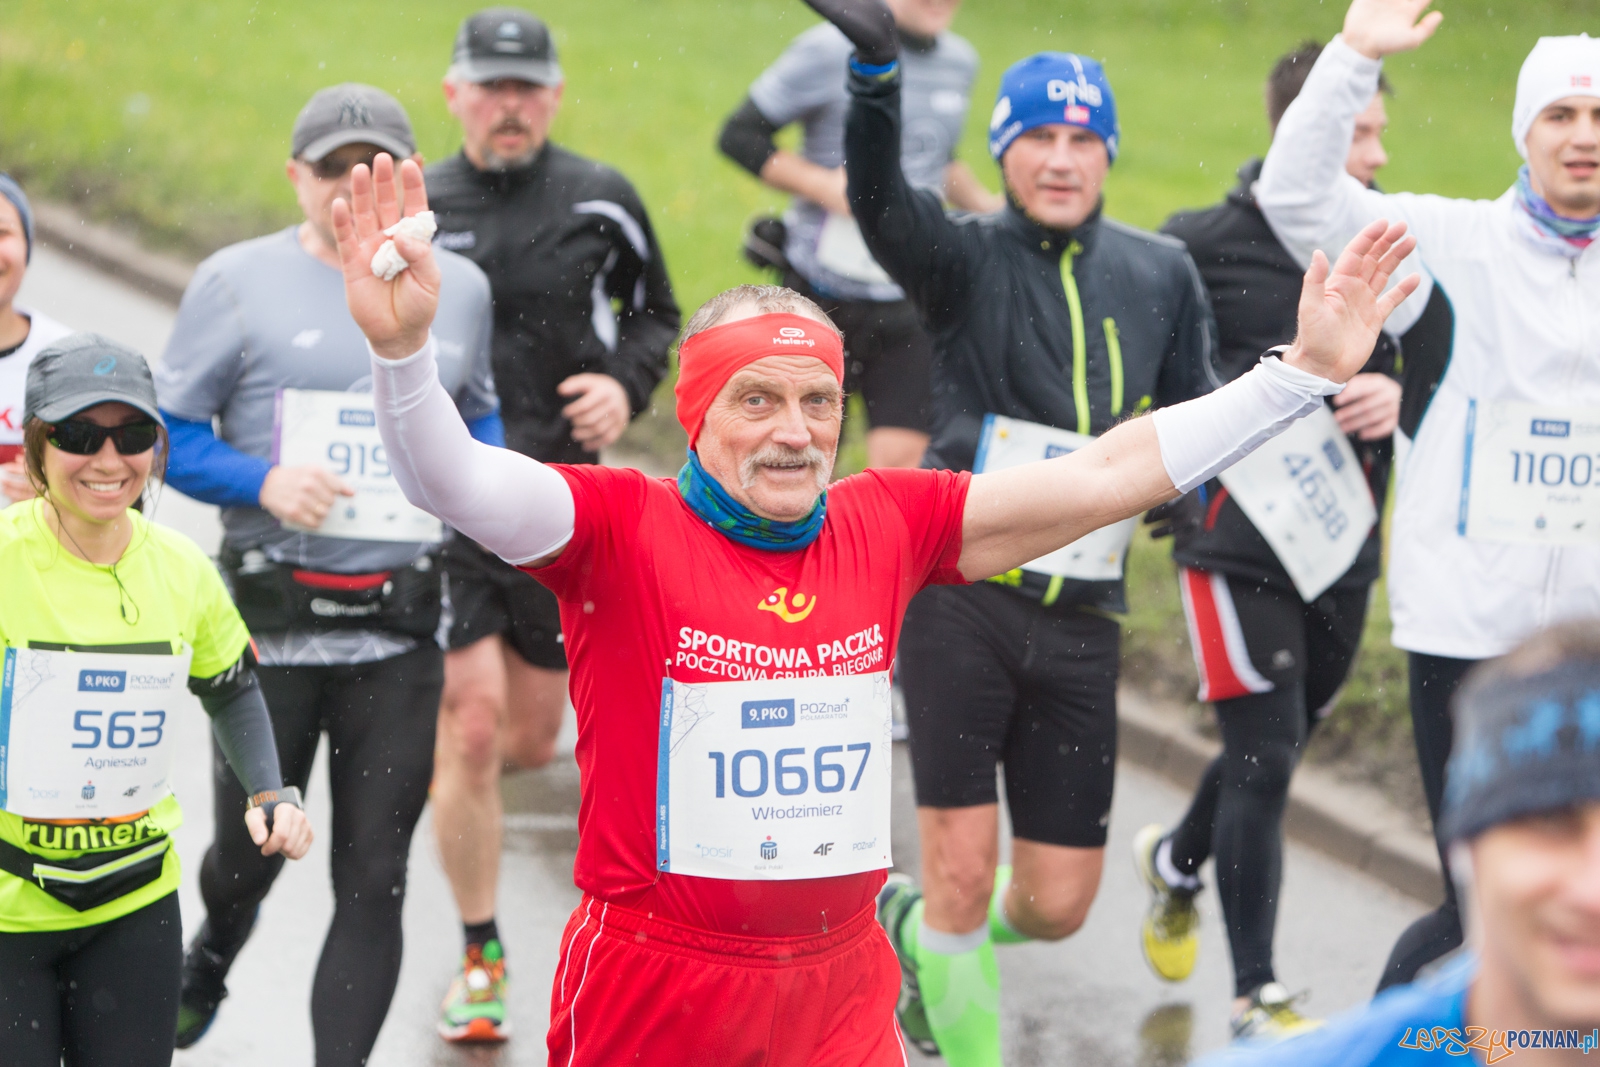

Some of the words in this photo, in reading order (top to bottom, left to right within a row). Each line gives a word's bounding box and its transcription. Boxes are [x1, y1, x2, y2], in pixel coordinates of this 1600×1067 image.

[772, 337, 815, 348] Kalenji
[676, 651, 769, 681] POCZTOWA
[832, 646, 884, 677] BIEGOWA
[678, 626, 812, 669] SPORTOWA
[817, 623, 884, 665] PACZKA
[71, 710, 166, 749] 563
[84, 756, 147, 769] Agnieszka
[708, 742, 872, 799] 10667
[751, 804, 843, 821] Włodzimierz
